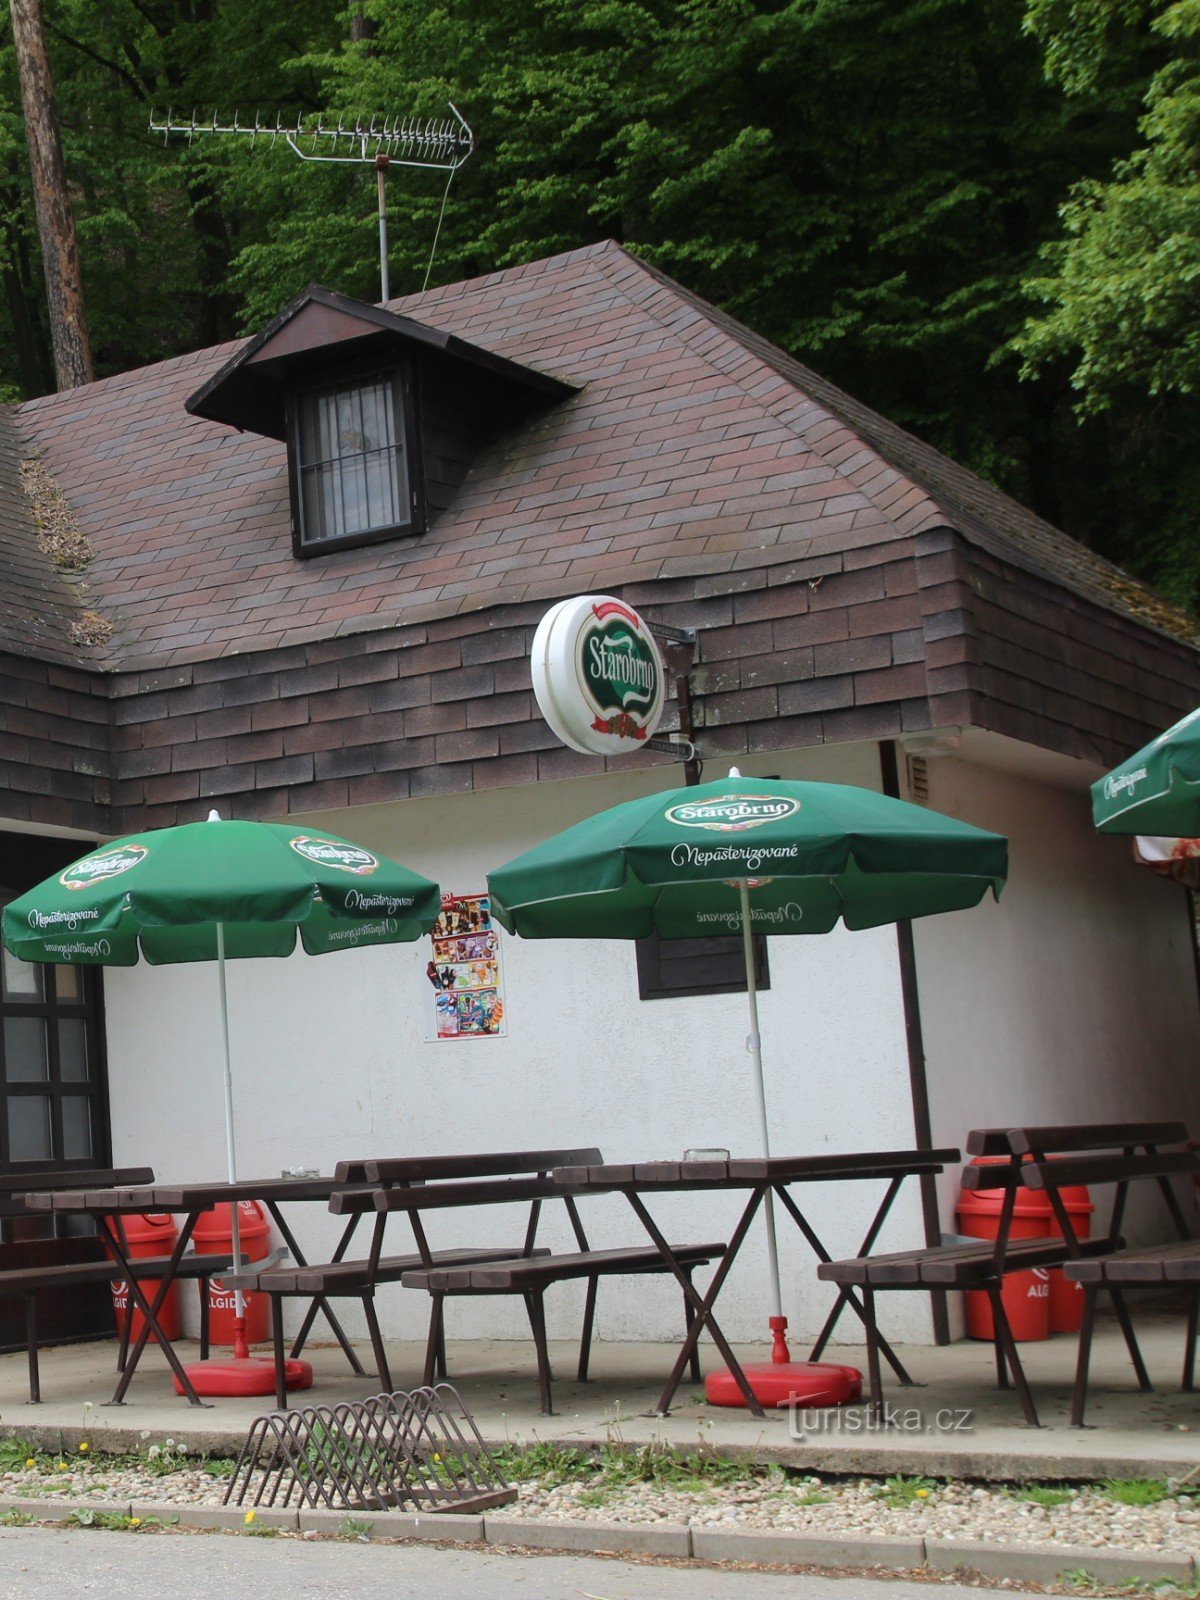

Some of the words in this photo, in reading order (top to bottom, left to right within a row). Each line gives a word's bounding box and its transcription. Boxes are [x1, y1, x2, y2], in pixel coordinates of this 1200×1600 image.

[589, 635, 654, 708] Starobrno
[679, 801, 790, 820] Starobrno
[670, 842, 798, 870] Nepasterizované
[1027, 1284, 1049, 1297] ALG
